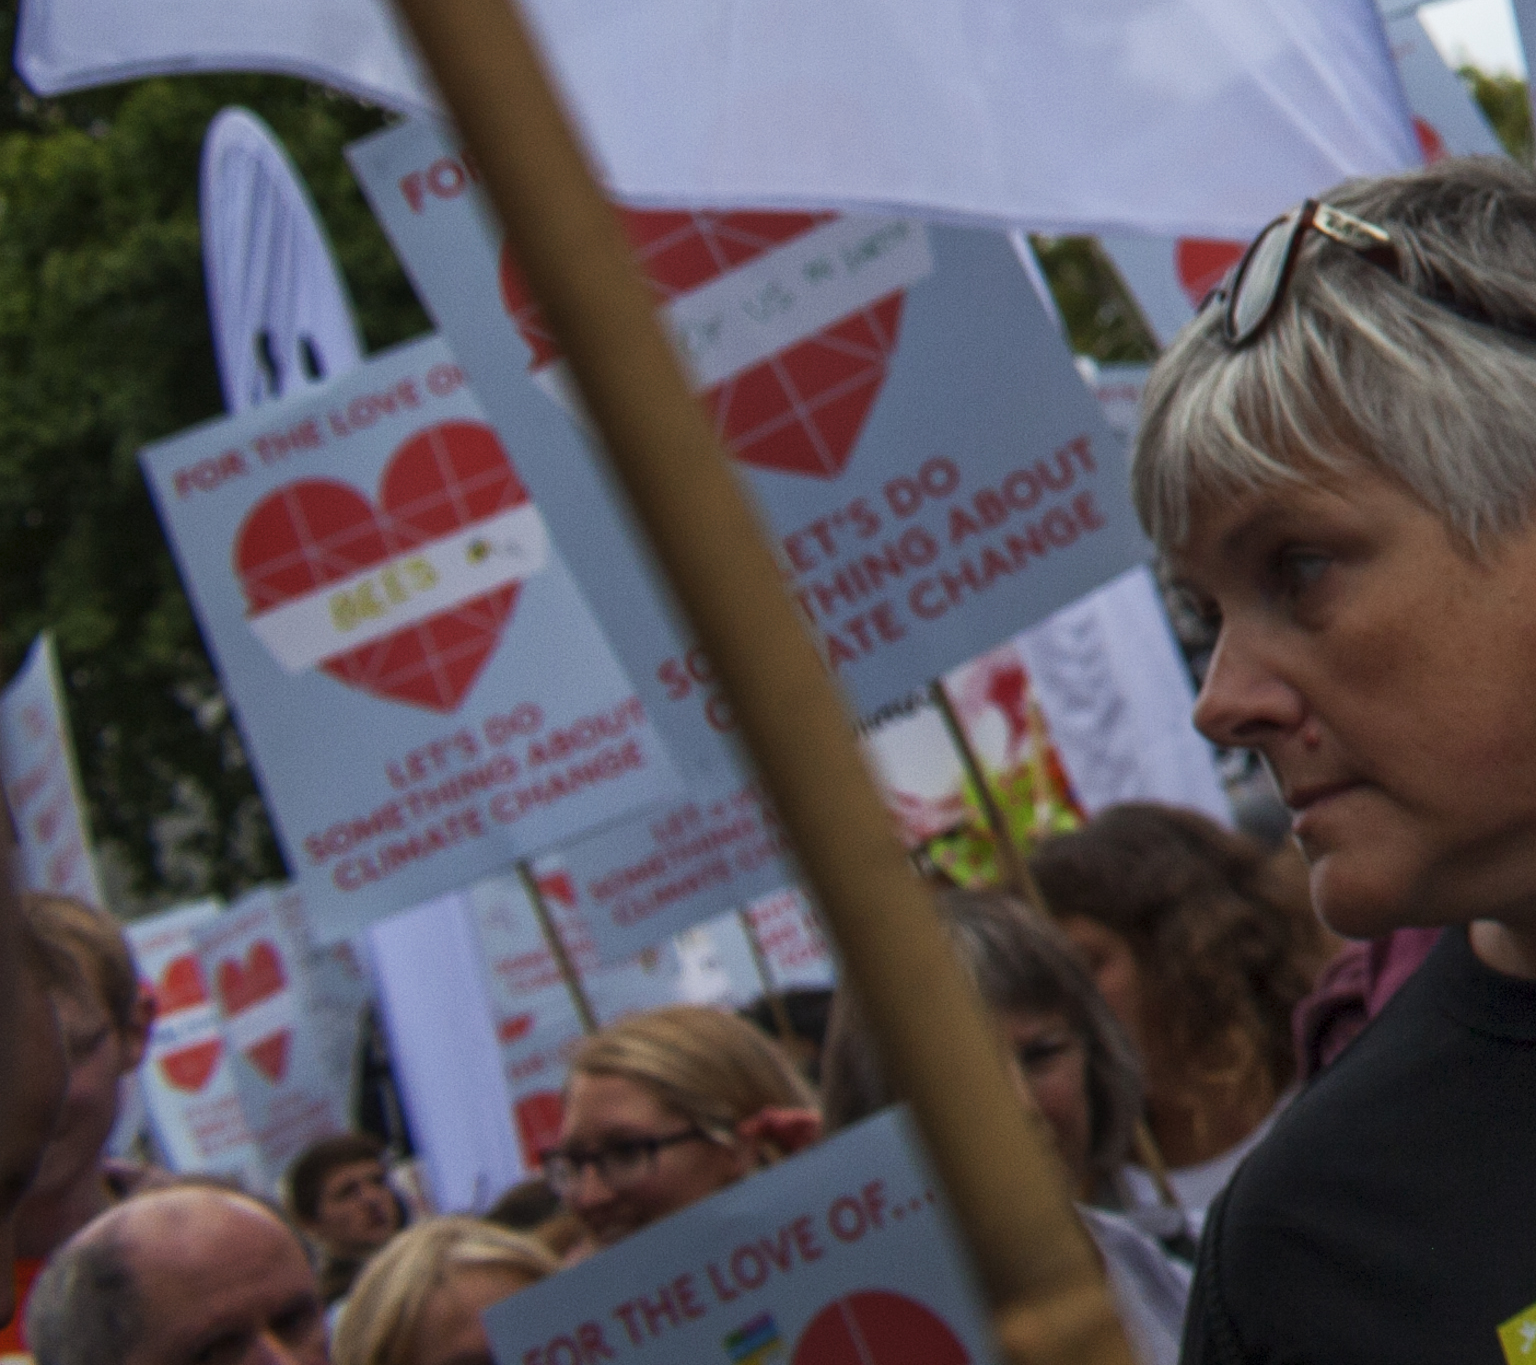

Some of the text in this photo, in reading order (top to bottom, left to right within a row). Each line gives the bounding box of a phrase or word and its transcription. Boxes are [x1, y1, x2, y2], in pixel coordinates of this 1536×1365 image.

[173, 449, 250, 500] FOR
[252, 416, 328, 467] THE
[329, 383, 422, 437] LOVE
[884, 455, 962, 516] DO
[947, 434, 1101, 559] ABOUT
[907, 488, 1108, 621] CHANGE
[304, 697, 648, 866] SOMETHING ABOUT
[384, 701, 545, 790] LET'S DO
[330, 803, 485, 894] CLIMATE
[489, 740, 647, 823] CHANGE
[611, 1272, 708, 1349] THE
[706, 1214, 826, 1306] LOVE
